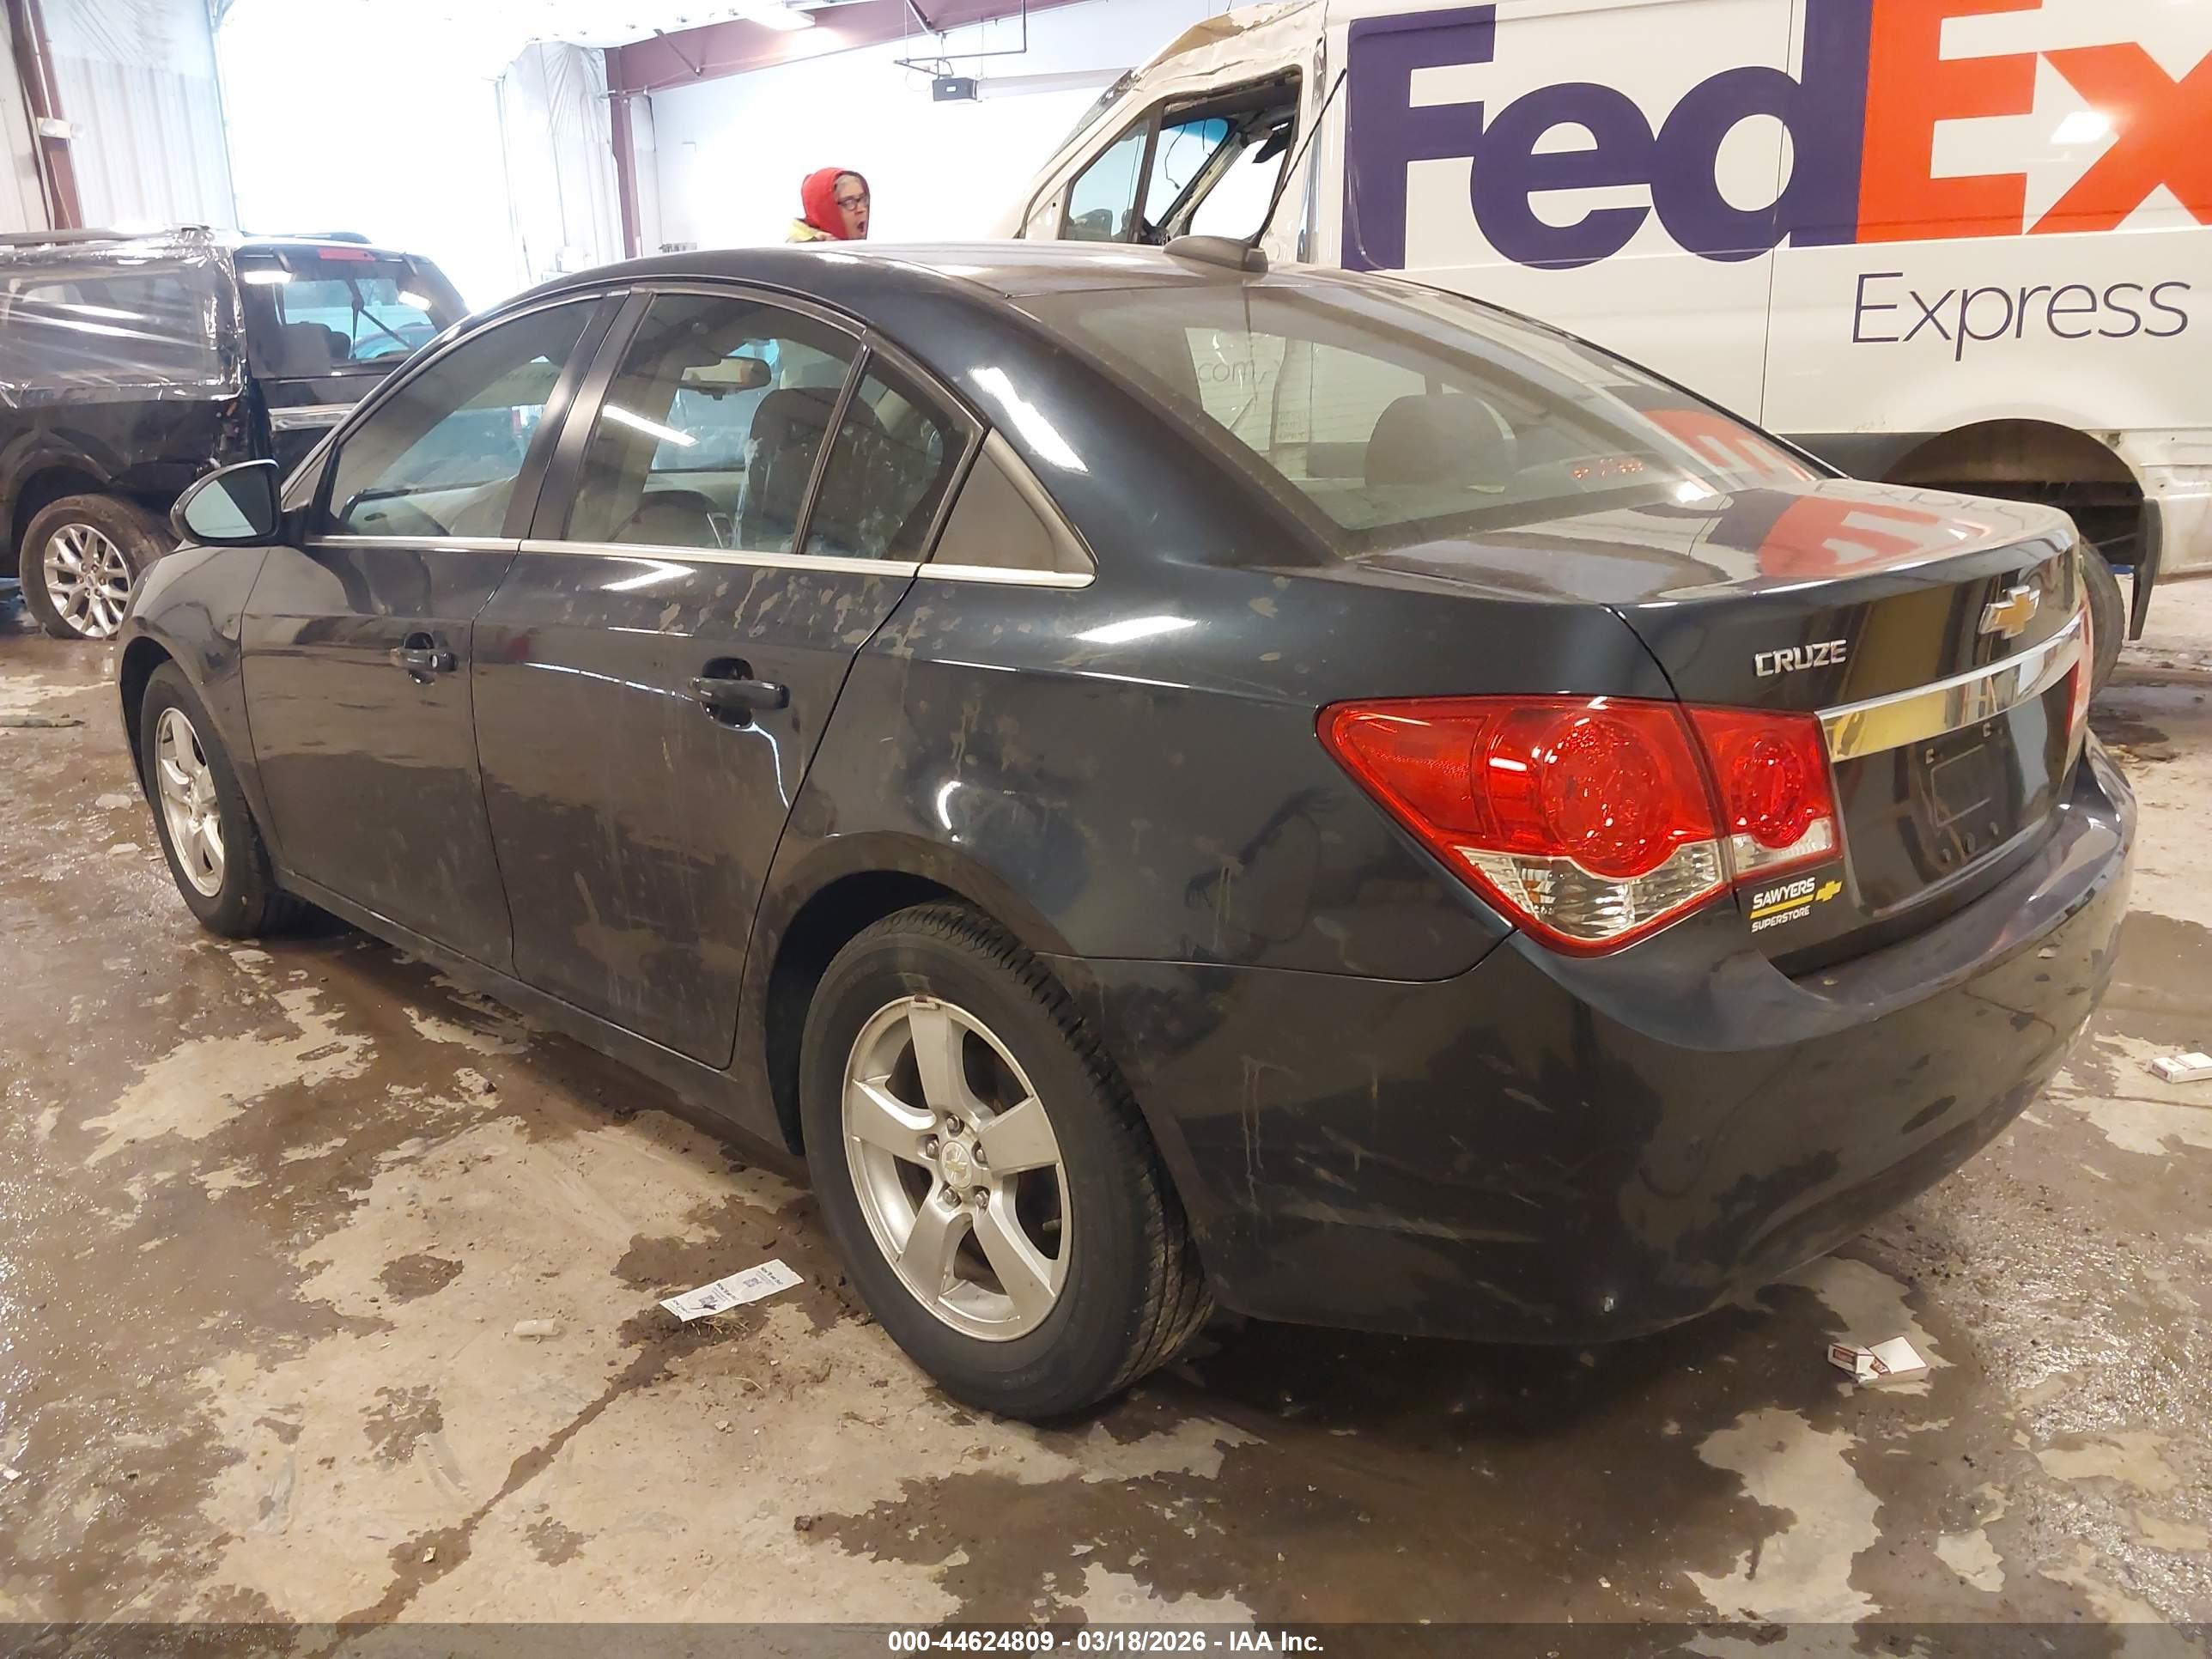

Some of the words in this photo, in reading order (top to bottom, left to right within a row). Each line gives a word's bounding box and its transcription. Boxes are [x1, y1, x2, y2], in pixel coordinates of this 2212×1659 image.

[1341, 0, 2212, 270] FedEx
[1852, 271, 2191, 362] Express
[1754, 639, 1847, 677] CRUZE
[1753, 877, 1815, 909] SAWYERS
[1752, 905, 1811, 933] SUPERSTORE
